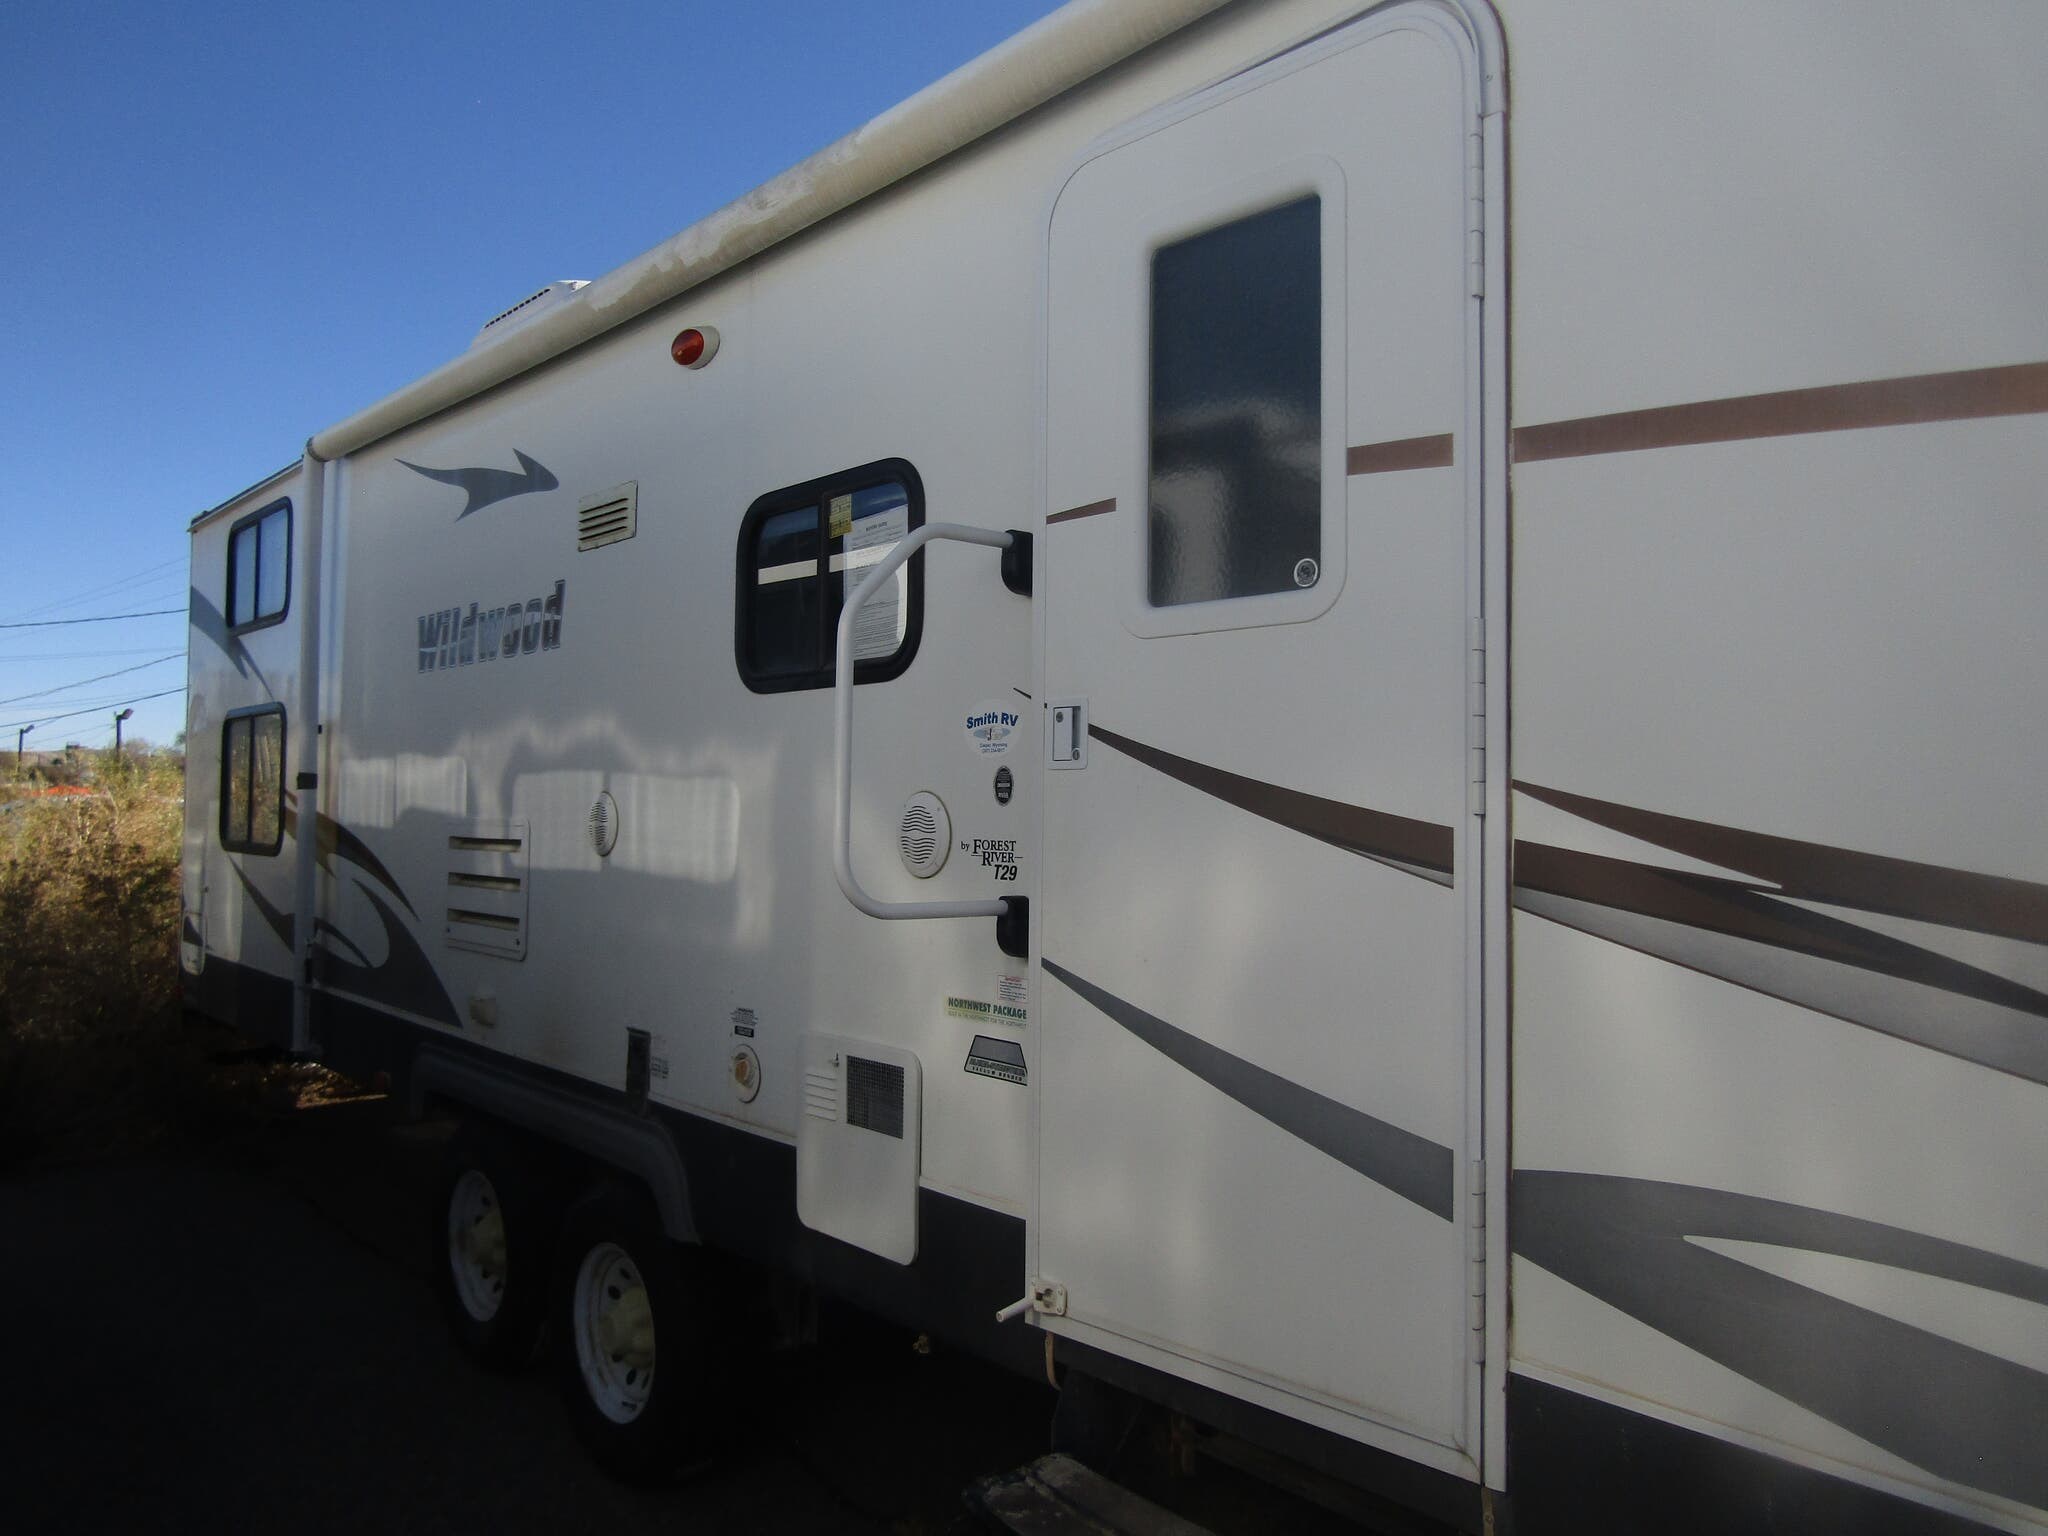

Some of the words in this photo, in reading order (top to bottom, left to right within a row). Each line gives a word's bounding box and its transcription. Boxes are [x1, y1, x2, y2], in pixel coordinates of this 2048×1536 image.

[966, 711, 998, 729] Smith
[1000, 711, 1019, 727] RV
[960, 840, 970, 851] by
[973, 839, 1017, 854] FOREST
[981, 850, 1015, 867] RIVER
[994, 864, 1018, 881] T29
[948, 996, 991, 1013] NORTHWEST
[993, 1003, 1027, 1020] PACKAGE
